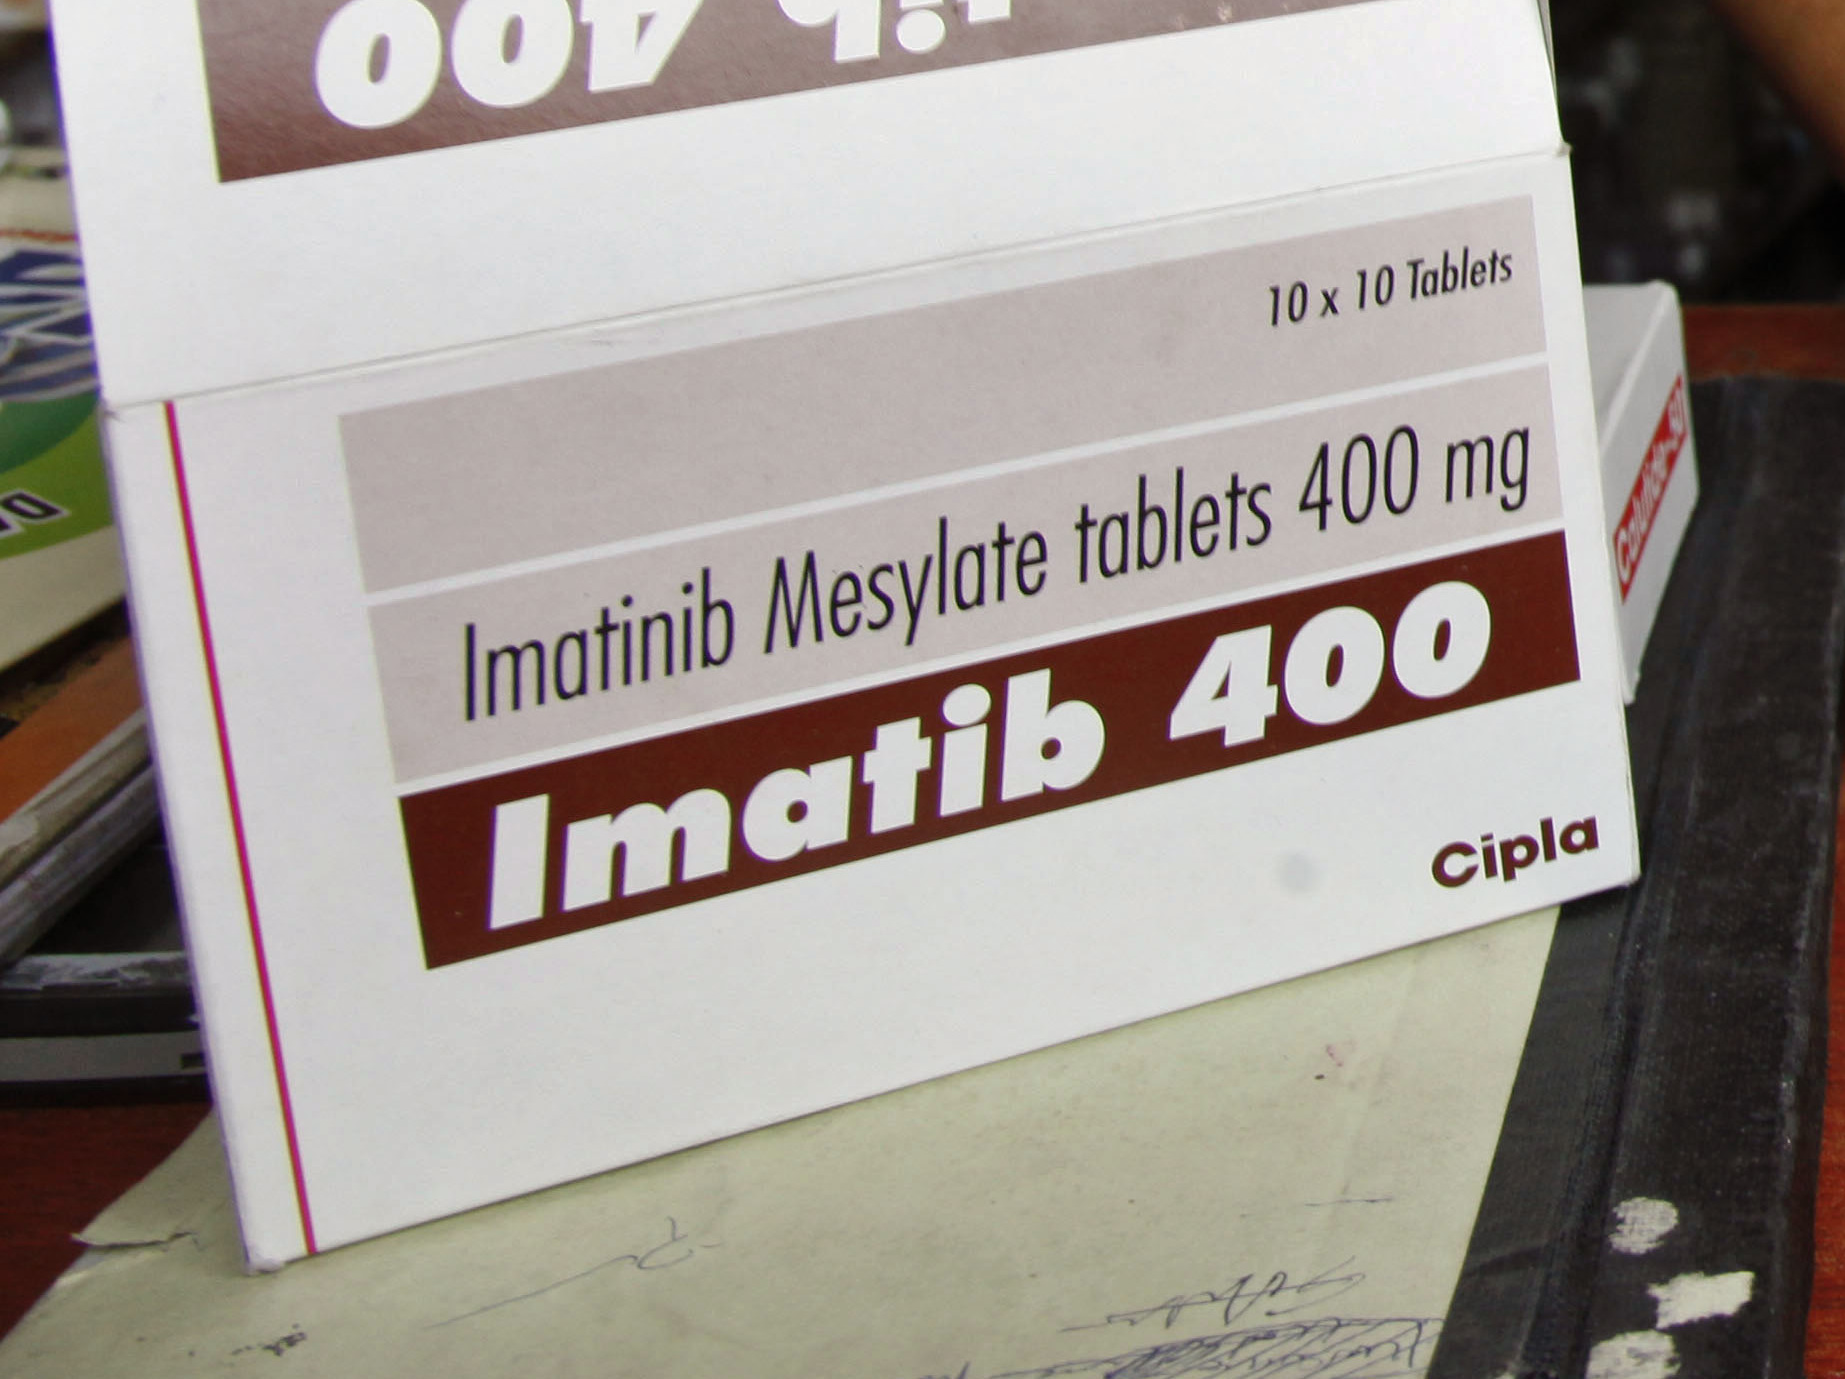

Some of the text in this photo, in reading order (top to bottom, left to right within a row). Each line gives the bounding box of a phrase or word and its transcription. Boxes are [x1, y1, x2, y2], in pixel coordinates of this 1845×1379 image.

[1268, 246, 1514, 327] 10 x 10 Tablets
[463, 425, 1531, 722] Imatinib Mesylate tablets 400 mg
[1617, 382, 1687, 586] Calutide-50
[488, 580, 1492, 931] Imatib 400
[1431, 815, 1600, 888] Cipla
